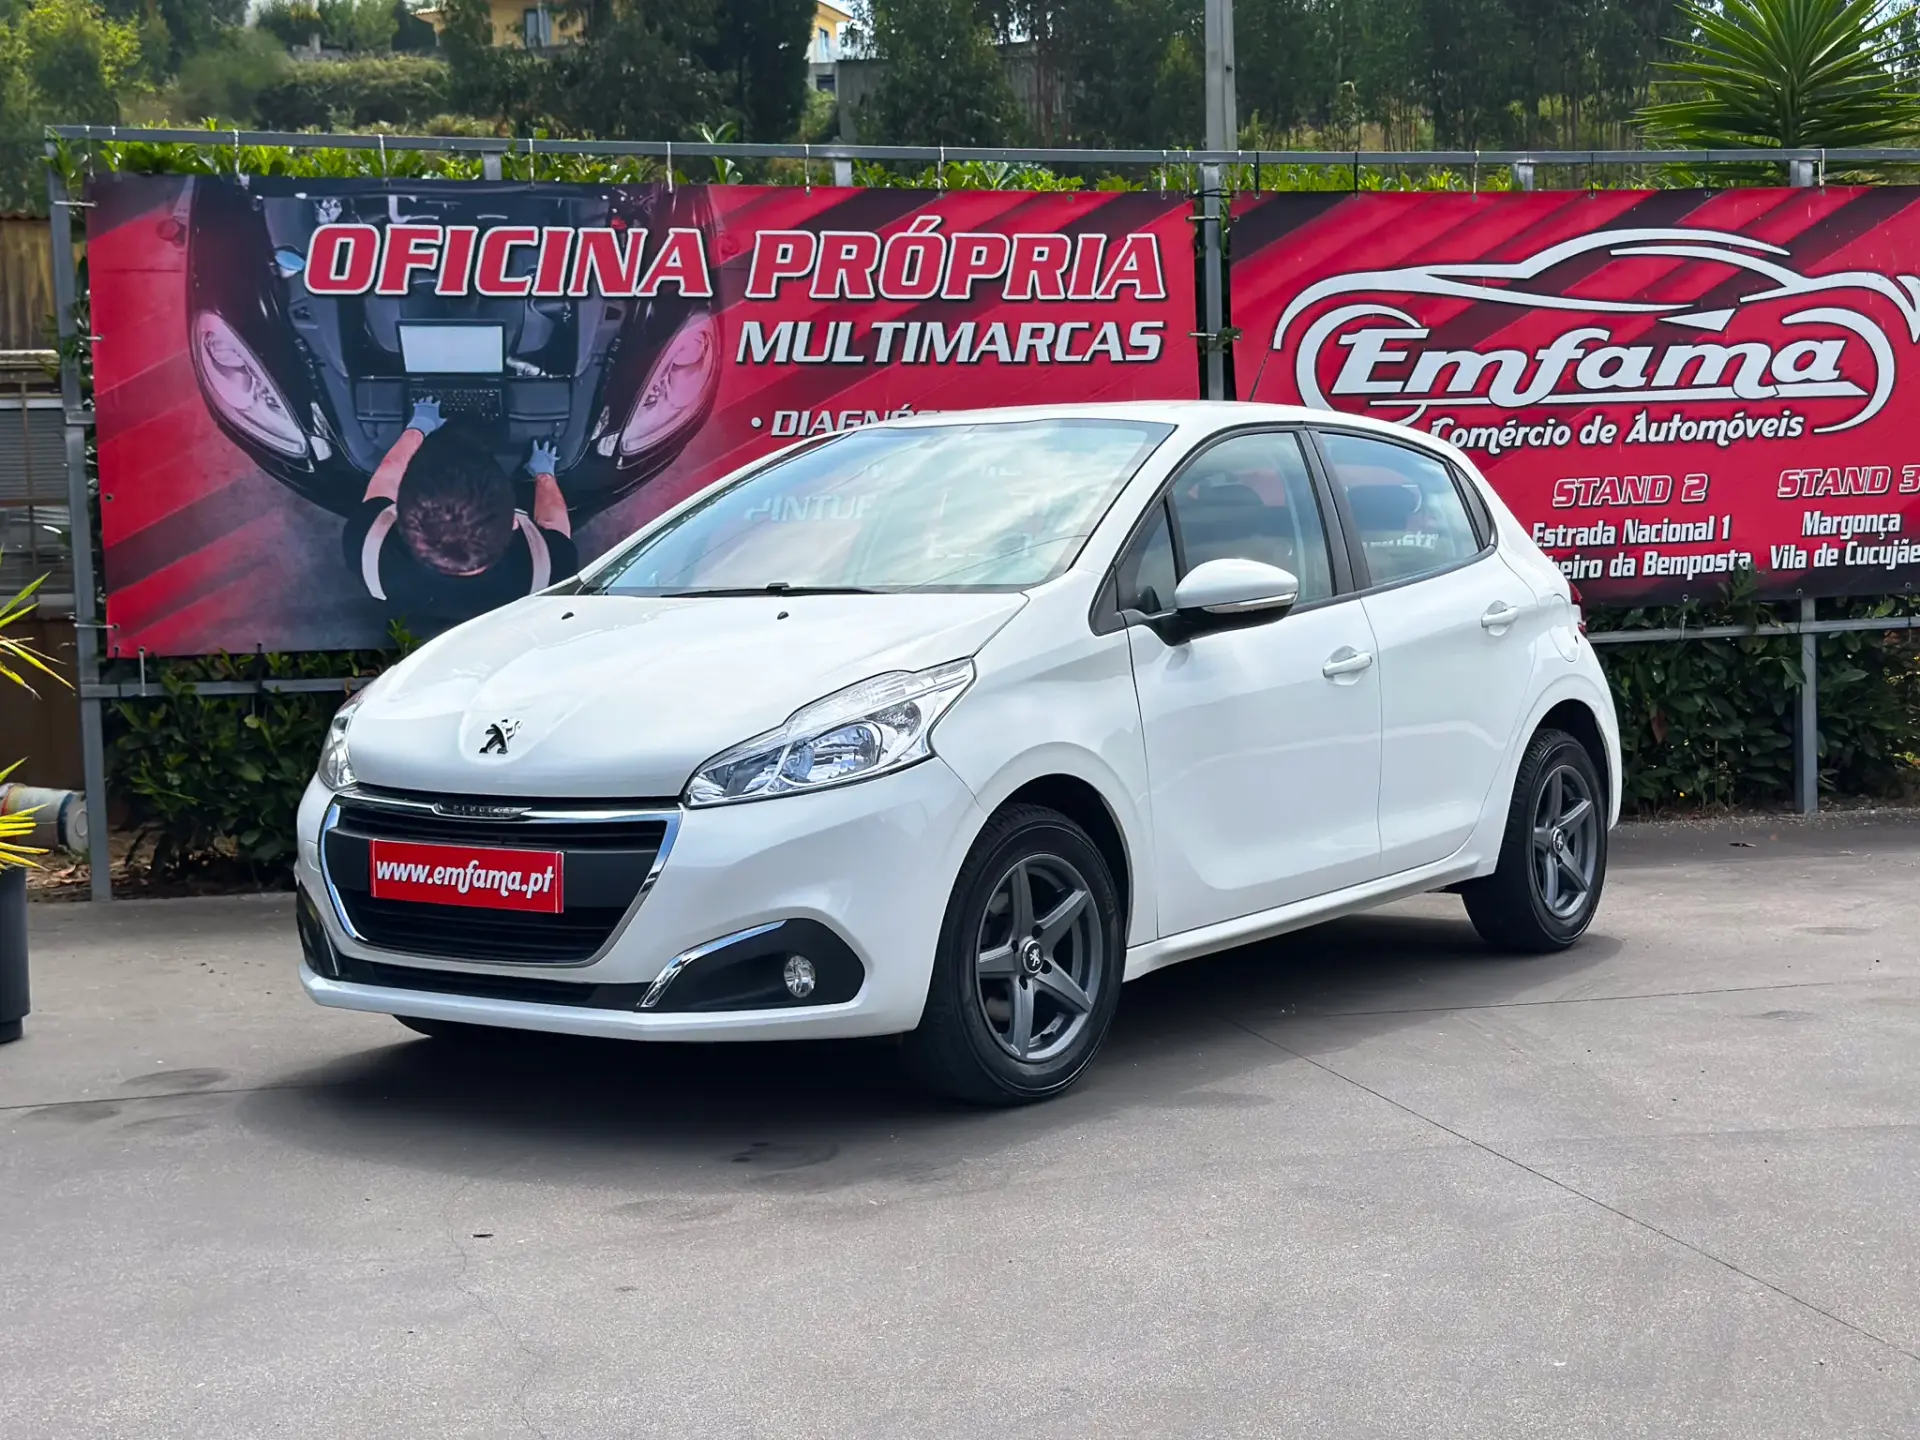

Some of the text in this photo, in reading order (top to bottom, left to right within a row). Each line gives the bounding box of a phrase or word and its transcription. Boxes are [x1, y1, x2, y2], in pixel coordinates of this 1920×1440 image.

[304, 215, 1167, 300] OFICINA PRÓPRIA
[735, 320, 1164, 363] MULTIMARCAS
[1332, 325, 1846, 408] Emfama
[1430, 409, 1804, 454] Comércio de Automóveis
[1552, 473, 1708, 508] STAND 2
[1777, 464, 1920, 498] STAND 3
[1532, 514, 1731, 547] Estrada Nacional 1
[1801, 511, 1901, 540] Margonça
[1609, 552, 1635, 577] da
[1642, 549, 1752, 581] Bemposta
[1770, 544, 1807, 569] Vila
[1813, 543, 1838, 568] de
[376, 860, 554, 899] www.emfama.pt
